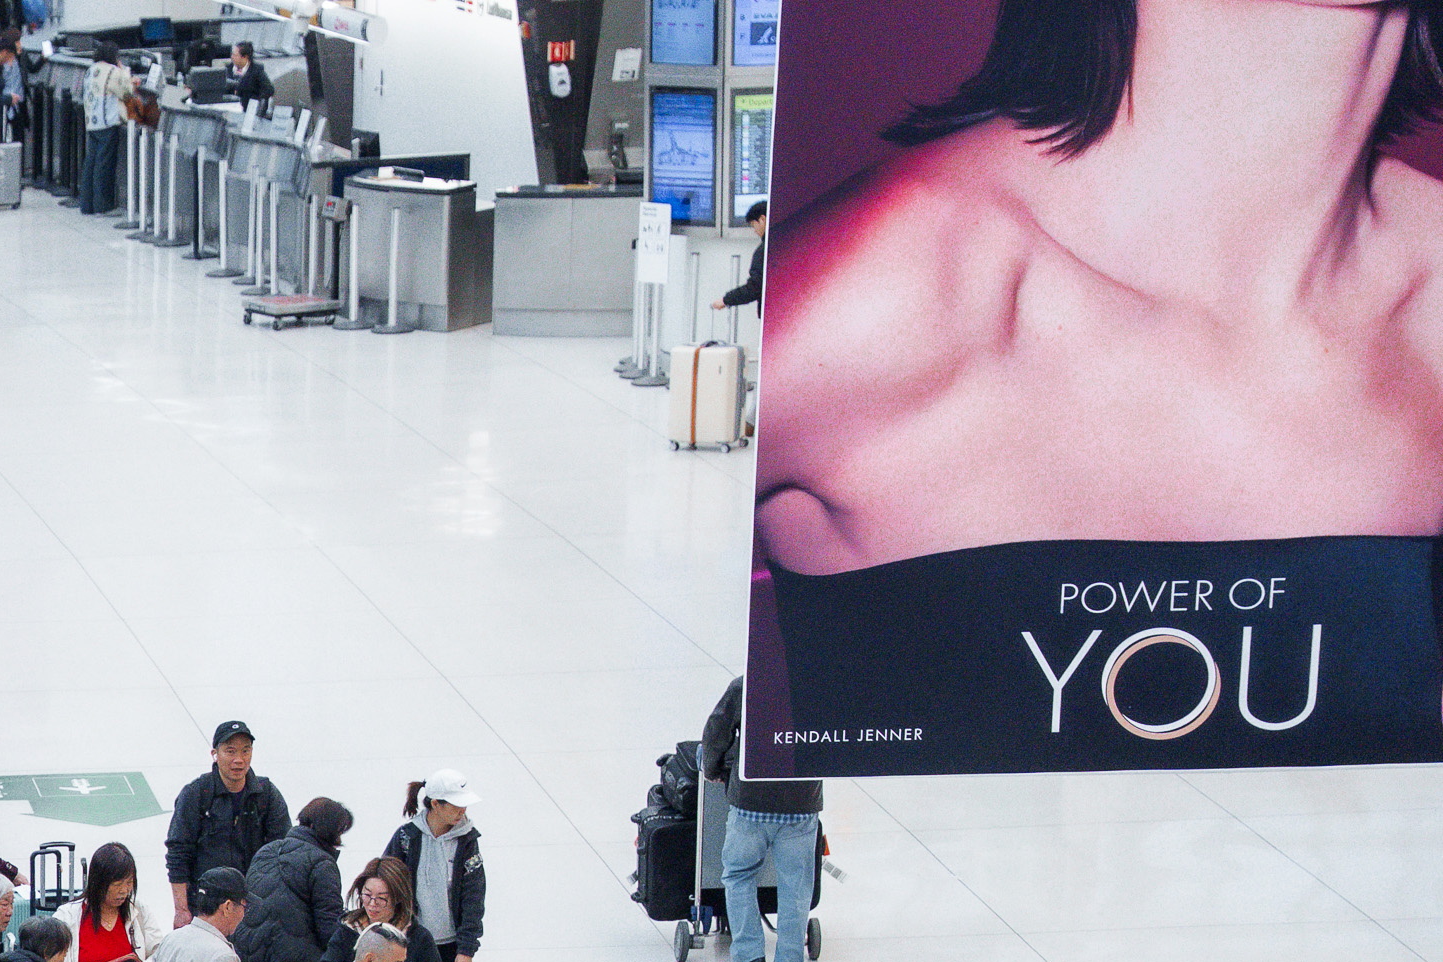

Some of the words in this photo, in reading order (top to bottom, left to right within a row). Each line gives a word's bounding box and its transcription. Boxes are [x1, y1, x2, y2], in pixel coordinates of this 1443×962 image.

[1060, 579, 1214, 614] POWER
[1228, 577, 1286, 610] OF
[1021, 623, 1323, 741] YOU
[773, 728, 850, 745] KENDALL
[856, 727, 924, 744] JENNER
